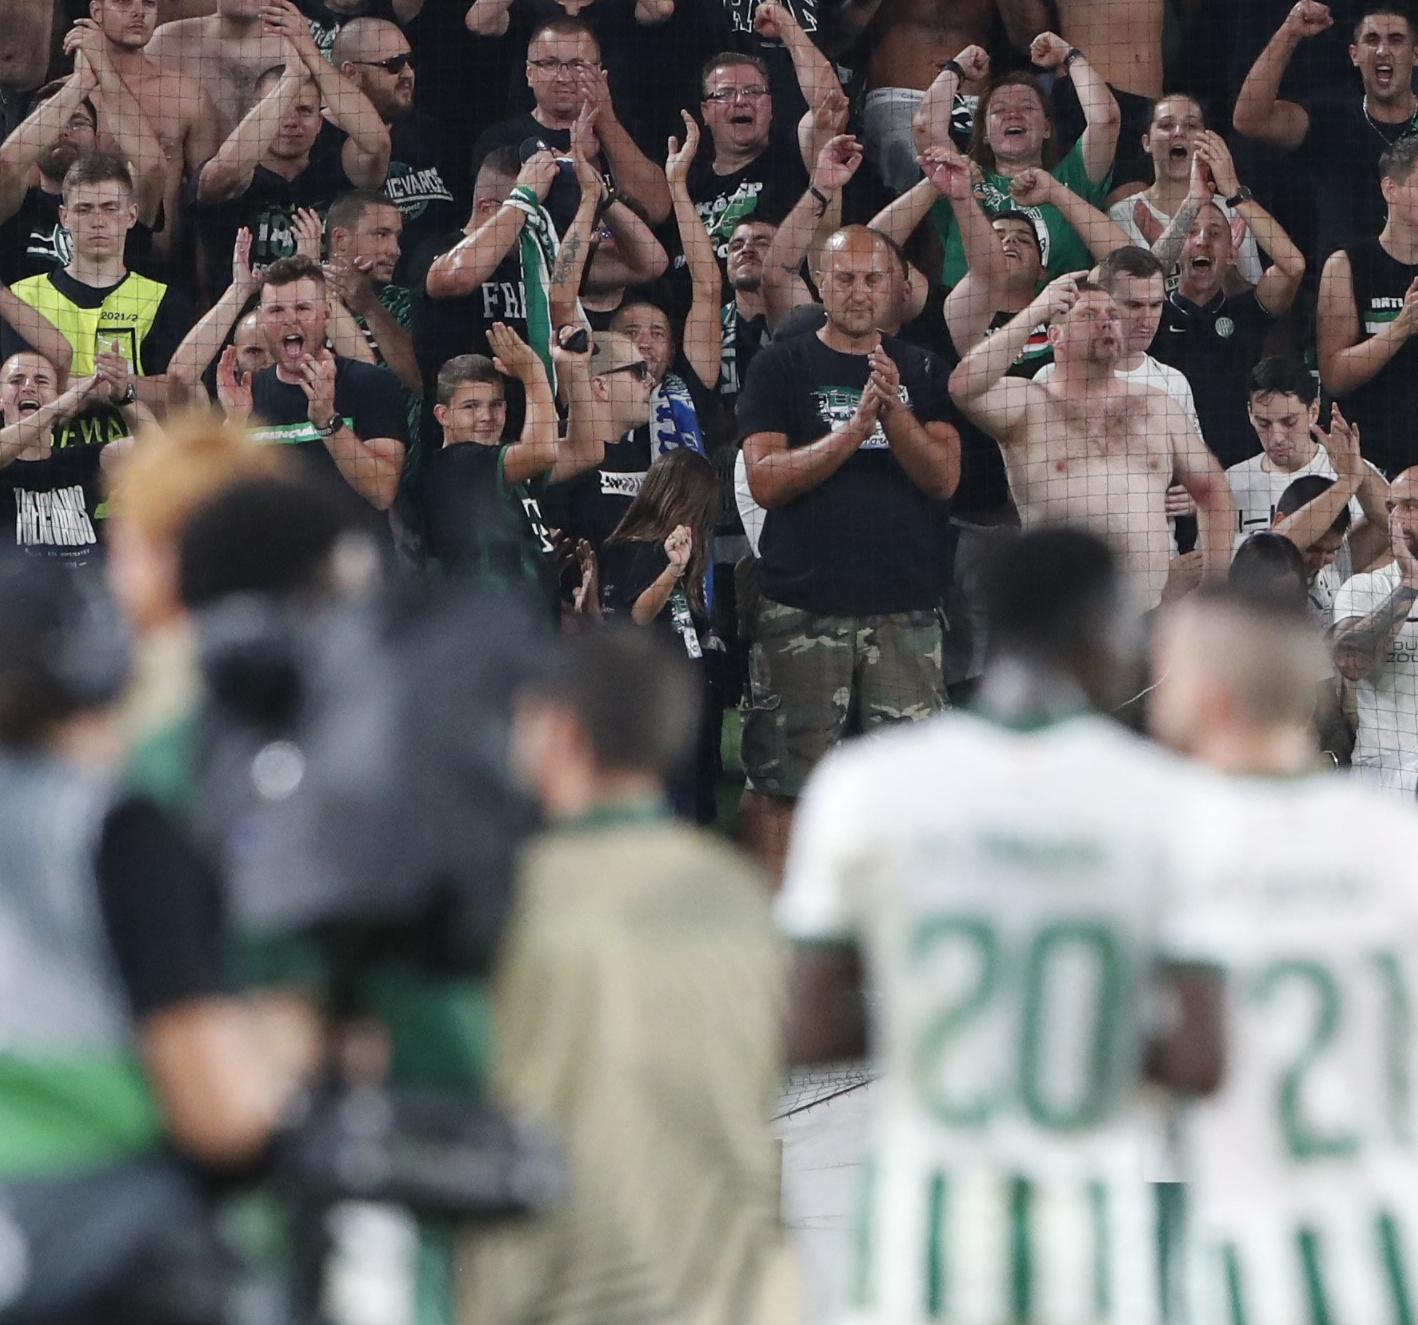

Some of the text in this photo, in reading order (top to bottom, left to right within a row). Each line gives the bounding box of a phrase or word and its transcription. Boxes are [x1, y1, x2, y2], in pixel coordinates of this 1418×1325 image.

[1370, 296, 1404, 309] ANTI
[907, 916, 1133, 1132] 20
[1244, 950, 1413, 1158] 21
